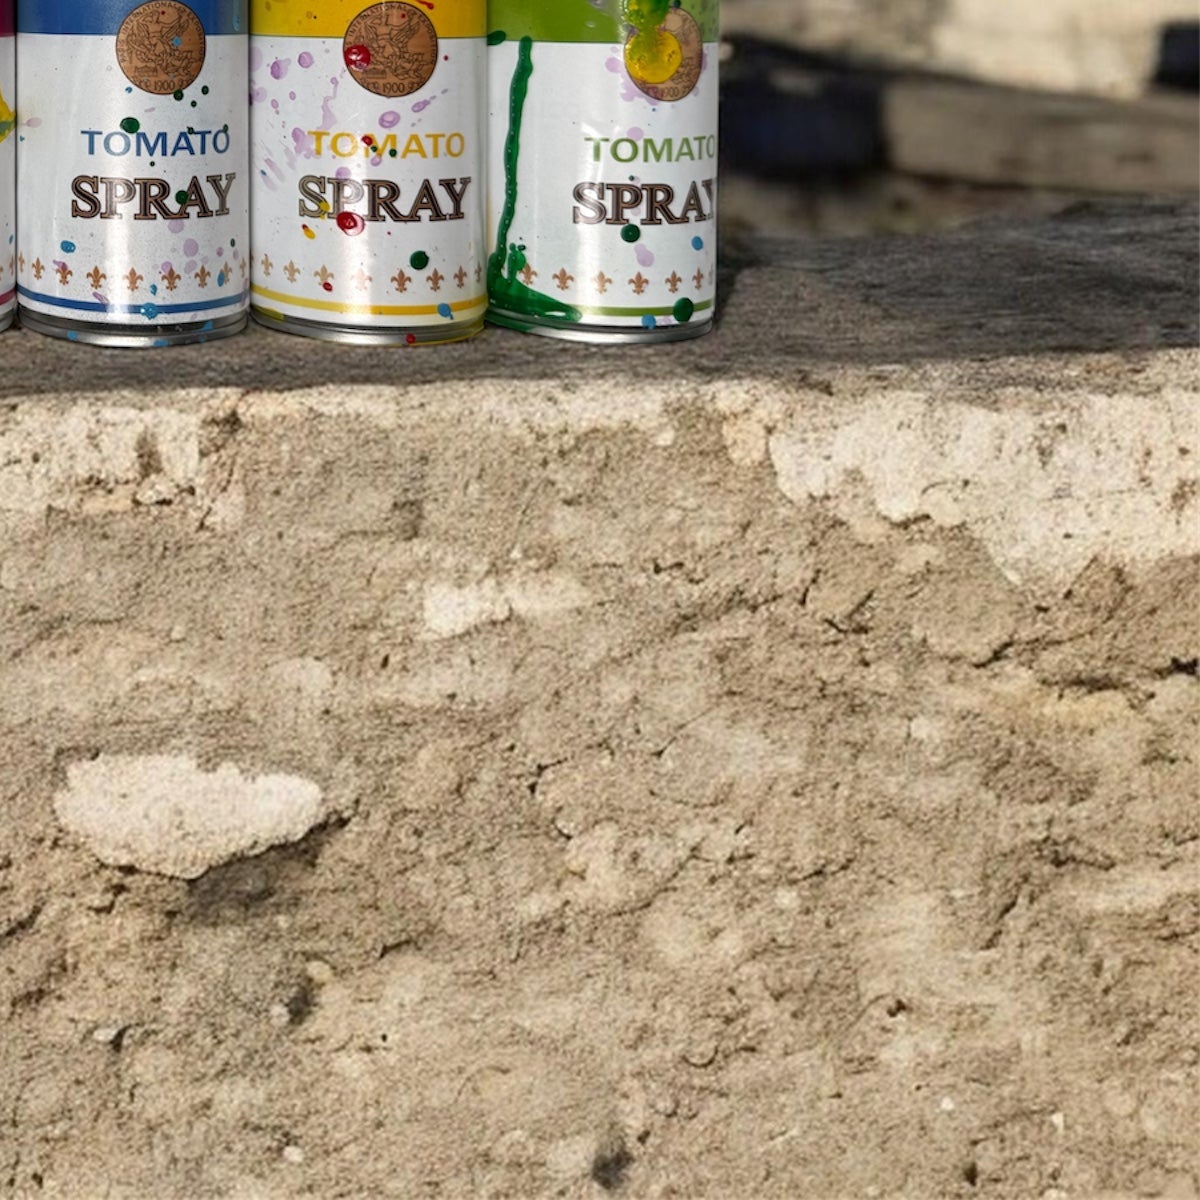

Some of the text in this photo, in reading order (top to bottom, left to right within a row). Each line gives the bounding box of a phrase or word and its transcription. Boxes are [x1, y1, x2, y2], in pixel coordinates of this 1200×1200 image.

[154, 81, 175, 91] 1900
[383, 83, 405, 93] 1900
[80, 129, 230, 157] TOMATO
[307, 130, 464, 159] TOMATO
[584, 135, 715, 163] TOMATO
[71, 173, 236, 220] SPRAY
[298, 174, 472, 222] SPRAY
